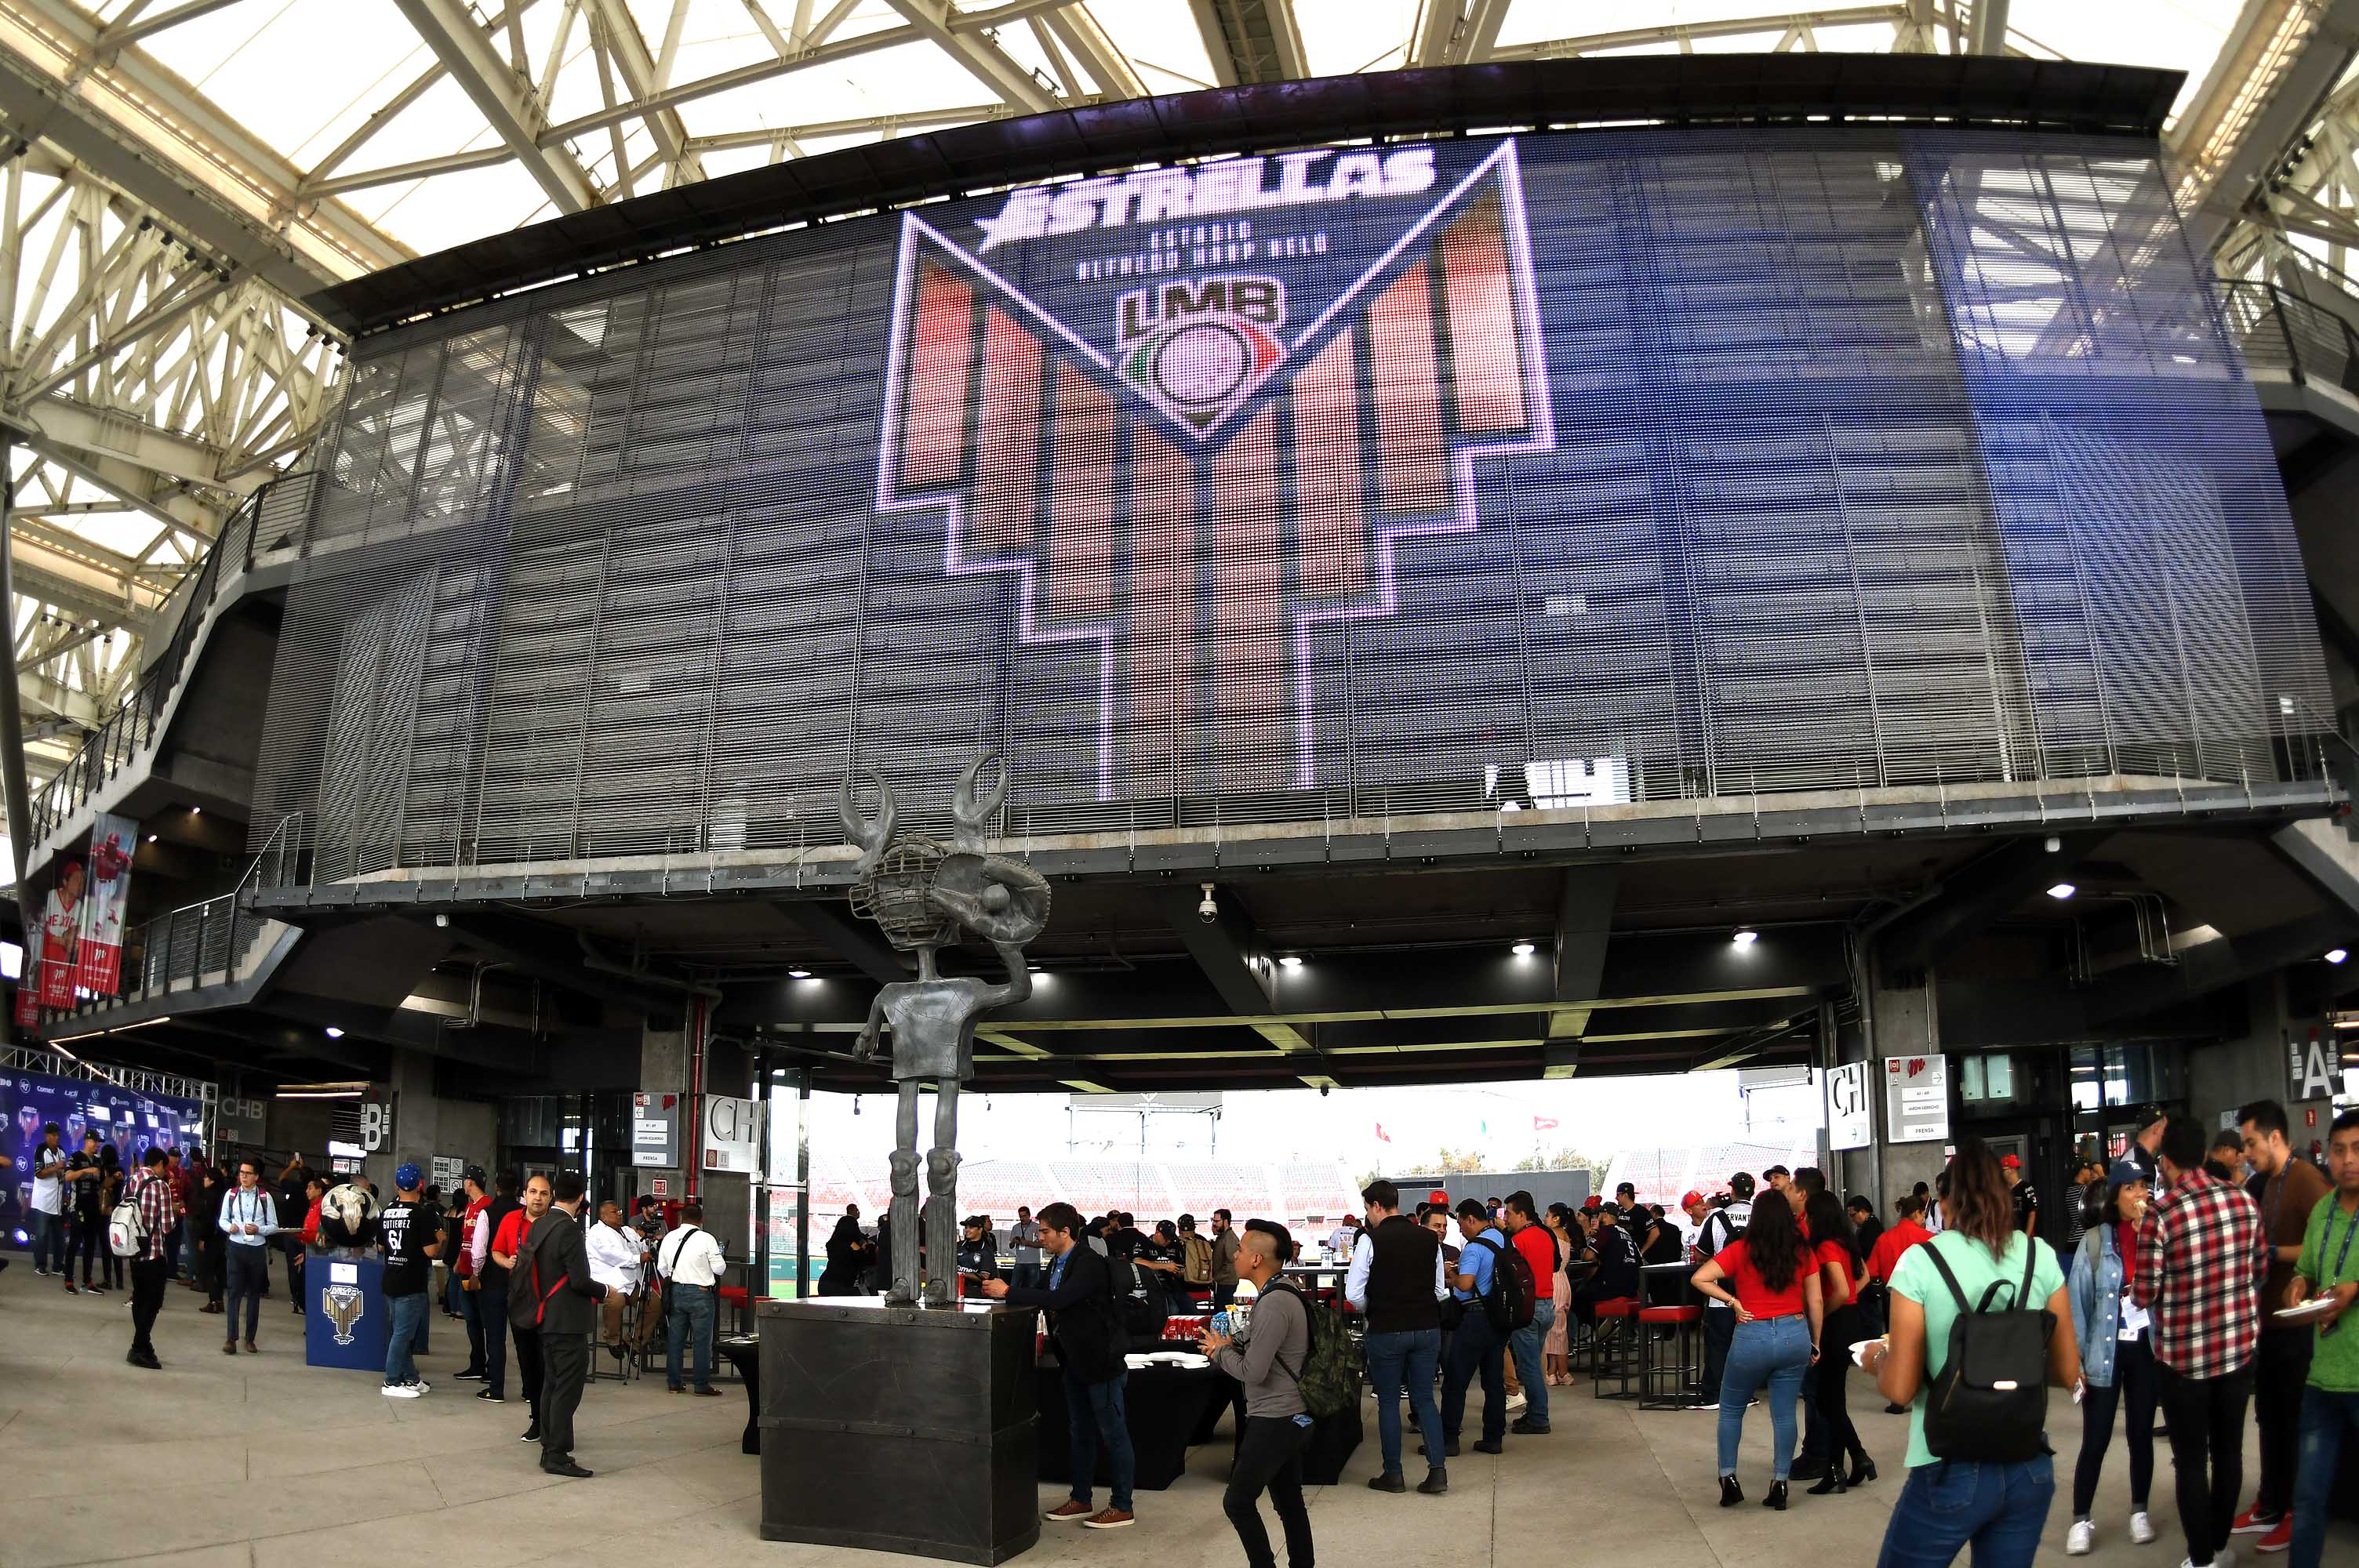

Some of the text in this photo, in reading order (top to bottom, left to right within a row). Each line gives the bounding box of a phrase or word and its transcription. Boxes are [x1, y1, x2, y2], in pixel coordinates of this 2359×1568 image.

[1118, 278, 1281, 340] LMB
[36, 1085, 56, 1094] Comex
[1830, 1062, 1866, 1117] CH
[2302, 1040, 2333, 1099] A
[222, 1098, 264, 1120] CHB
[364, 1103, 383, 1151] B
[710, 1098, 757, 1143] CH
